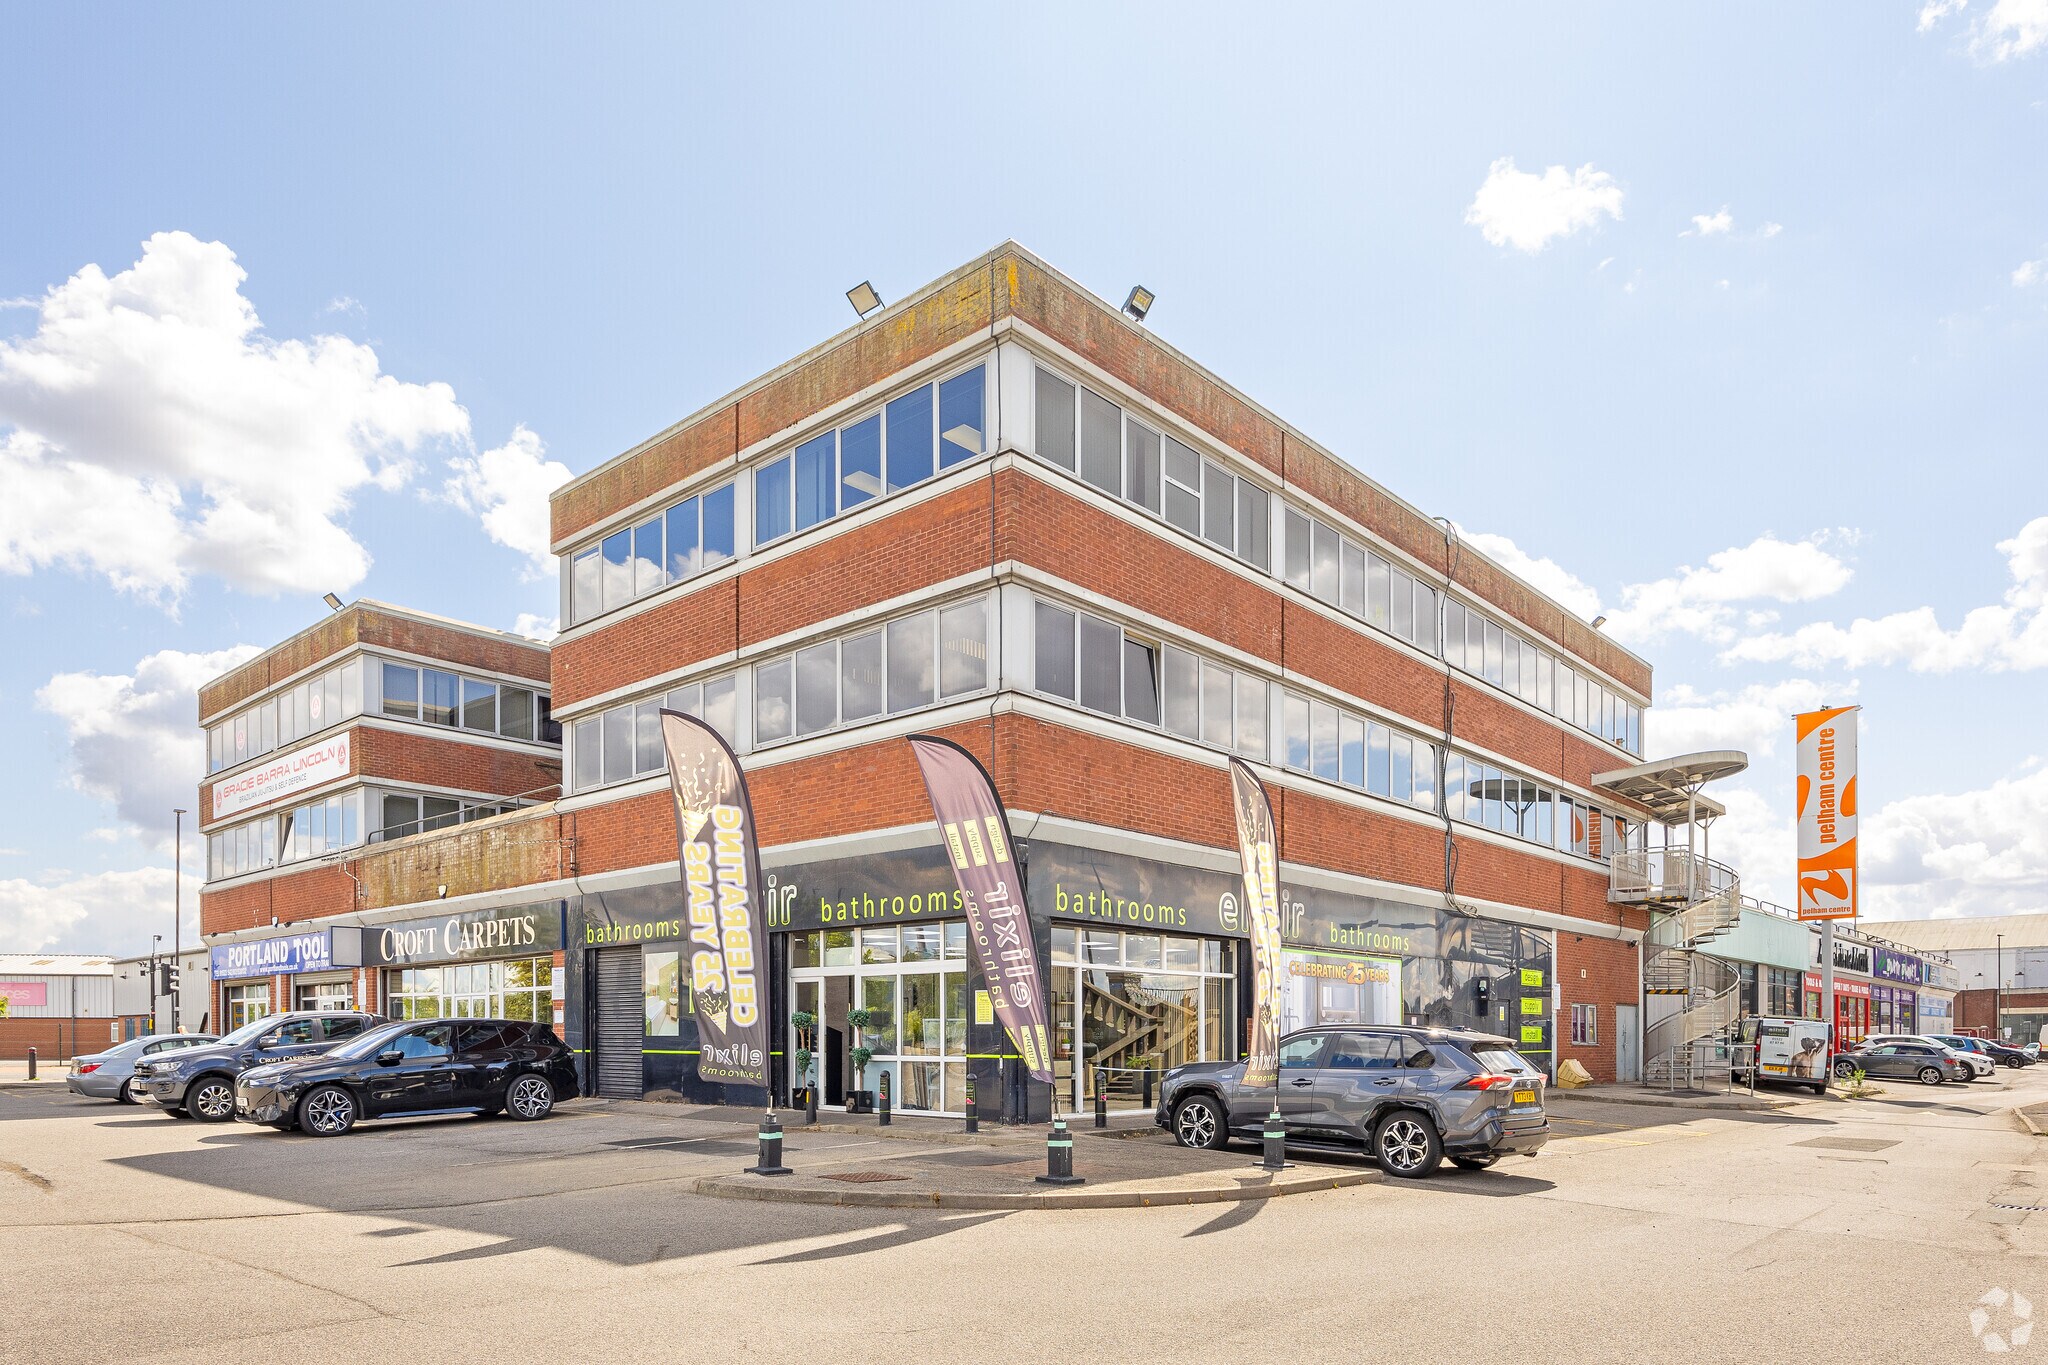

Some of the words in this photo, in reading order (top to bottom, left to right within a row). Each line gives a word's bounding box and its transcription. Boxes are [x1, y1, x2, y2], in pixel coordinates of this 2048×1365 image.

[1818, 727, 1835, 781] centre
[223, 777, 255, 798] GRACIE
[257, 764, 290, 785] BARRA
[293, 746, 336, 772] LINCOLN
[1817, 784, 1837, 844] pelham
[821, 888, 963, 922] bathrooms
[1056, 884, 1186, 926] bathrooms
[1218, 881, 1305, 939] elir
[1330, 921, 1409, 951] bathrooms
[1802, 906, 1828, 915] pelham
[1828, 905, 1851, 914] centre
[380, 927, 437, 962] CROFT
[443, 915, 536, 955] CARPETS
[586, 919, 680, 944] bathrooms
[228, 941, 288, 967] PORTLAND
[293, 935, 329, 963] TOOL
[1288, 960, 1347, 980] CELEBRATING
[1346, 962, 1367, 985] 25
[1365, 967, 1389, 983] YEARS
[1524, 973, 1539, 984] design
[0, 985, 31, 1000] ices
[1524, 1001, 1539, 1011] supply
[1525, 1029, 1539, 1037] install
